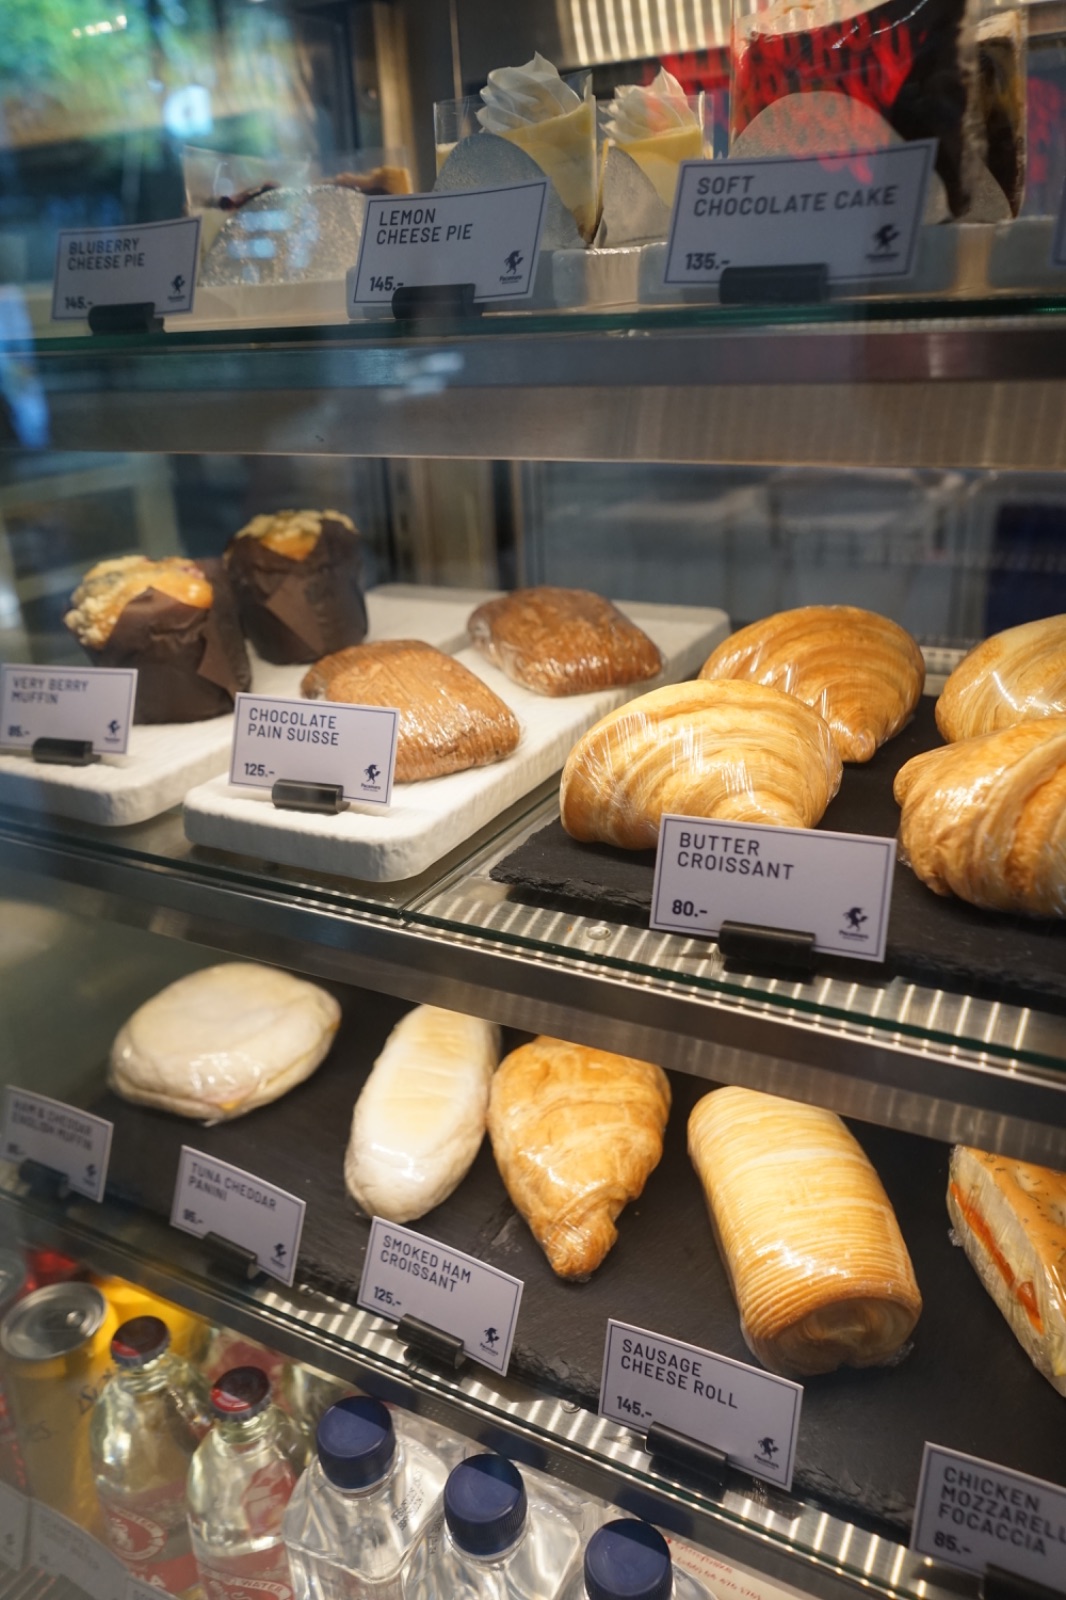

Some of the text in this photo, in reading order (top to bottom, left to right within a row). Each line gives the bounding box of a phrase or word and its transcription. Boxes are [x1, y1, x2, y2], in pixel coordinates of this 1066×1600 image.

[697, 176, 754, 195] SOFT
[693, 185, 898, 217] CHOCOLATE CAKE
[379, 208, 436, 226] LEMON
[376, 223, 473, 245] CHEESE PIE
[69, 238, 140, 255] BLUBERRY
[67, 253, 145, 270] CHEESE PIE
[685, 252, 730, 270] 135.-
[370, 276, 404, 291] 145.-
[13, 676, 88, 692] VERY BERRY
[249, 707, 337, 729] CHOCOLATE
[248, 723, 340, 746] PAIN SUISSE
[244, 763, 275, 778] 125.-
[679, 832, 760, 856] BUTTER
[677, 851, 794, 880] CROISSANT
[672, 899, 708, 918] 80.-
[188, 1175, 228, 1201] PANINI
[191, 1162, 277, 1211] TUNA CHEDDAR
[383, 1234, 472, 1284] SMOKED HAM
[380, 1250, 457, 1293] CROISSANT
[374, 1286, 402, 1307] 125.-
[622, 1339, 702, 1378] SAUSAGE
[621, 1355, 738, 1409] CHEESE ROLL
[617, 1395, 652, 1418] 145.-
[944, 1466, 1040, 1512] CHICKEN
[938, 1502, 1046, 1556] FOCACCIA
[934, 1531, 972, 1554] 85.-
